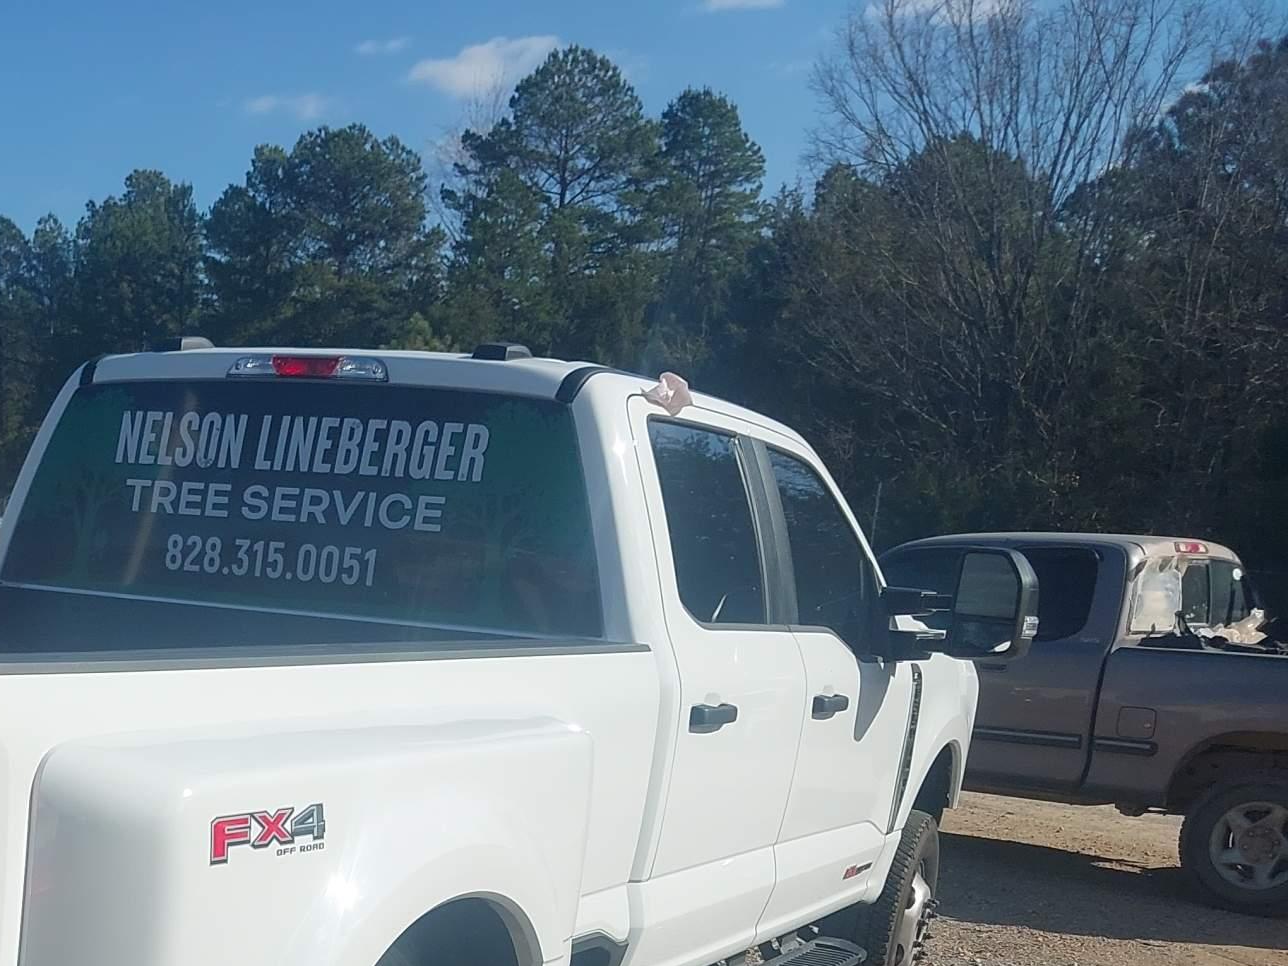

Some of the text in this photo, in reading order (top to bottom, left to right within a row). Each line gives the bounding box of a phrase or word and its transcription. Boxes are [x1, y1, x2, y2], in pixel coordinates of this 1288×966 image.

[114, 410, 490, 482] NELSON LINEBERGER
[125, 478, 447, 532] TREE SERVICE
[164, 533, 378, 587] 828.315.0051
[209, 803, 326, 866] FX4
[276, 842, 325, 857] OFF ROAD
